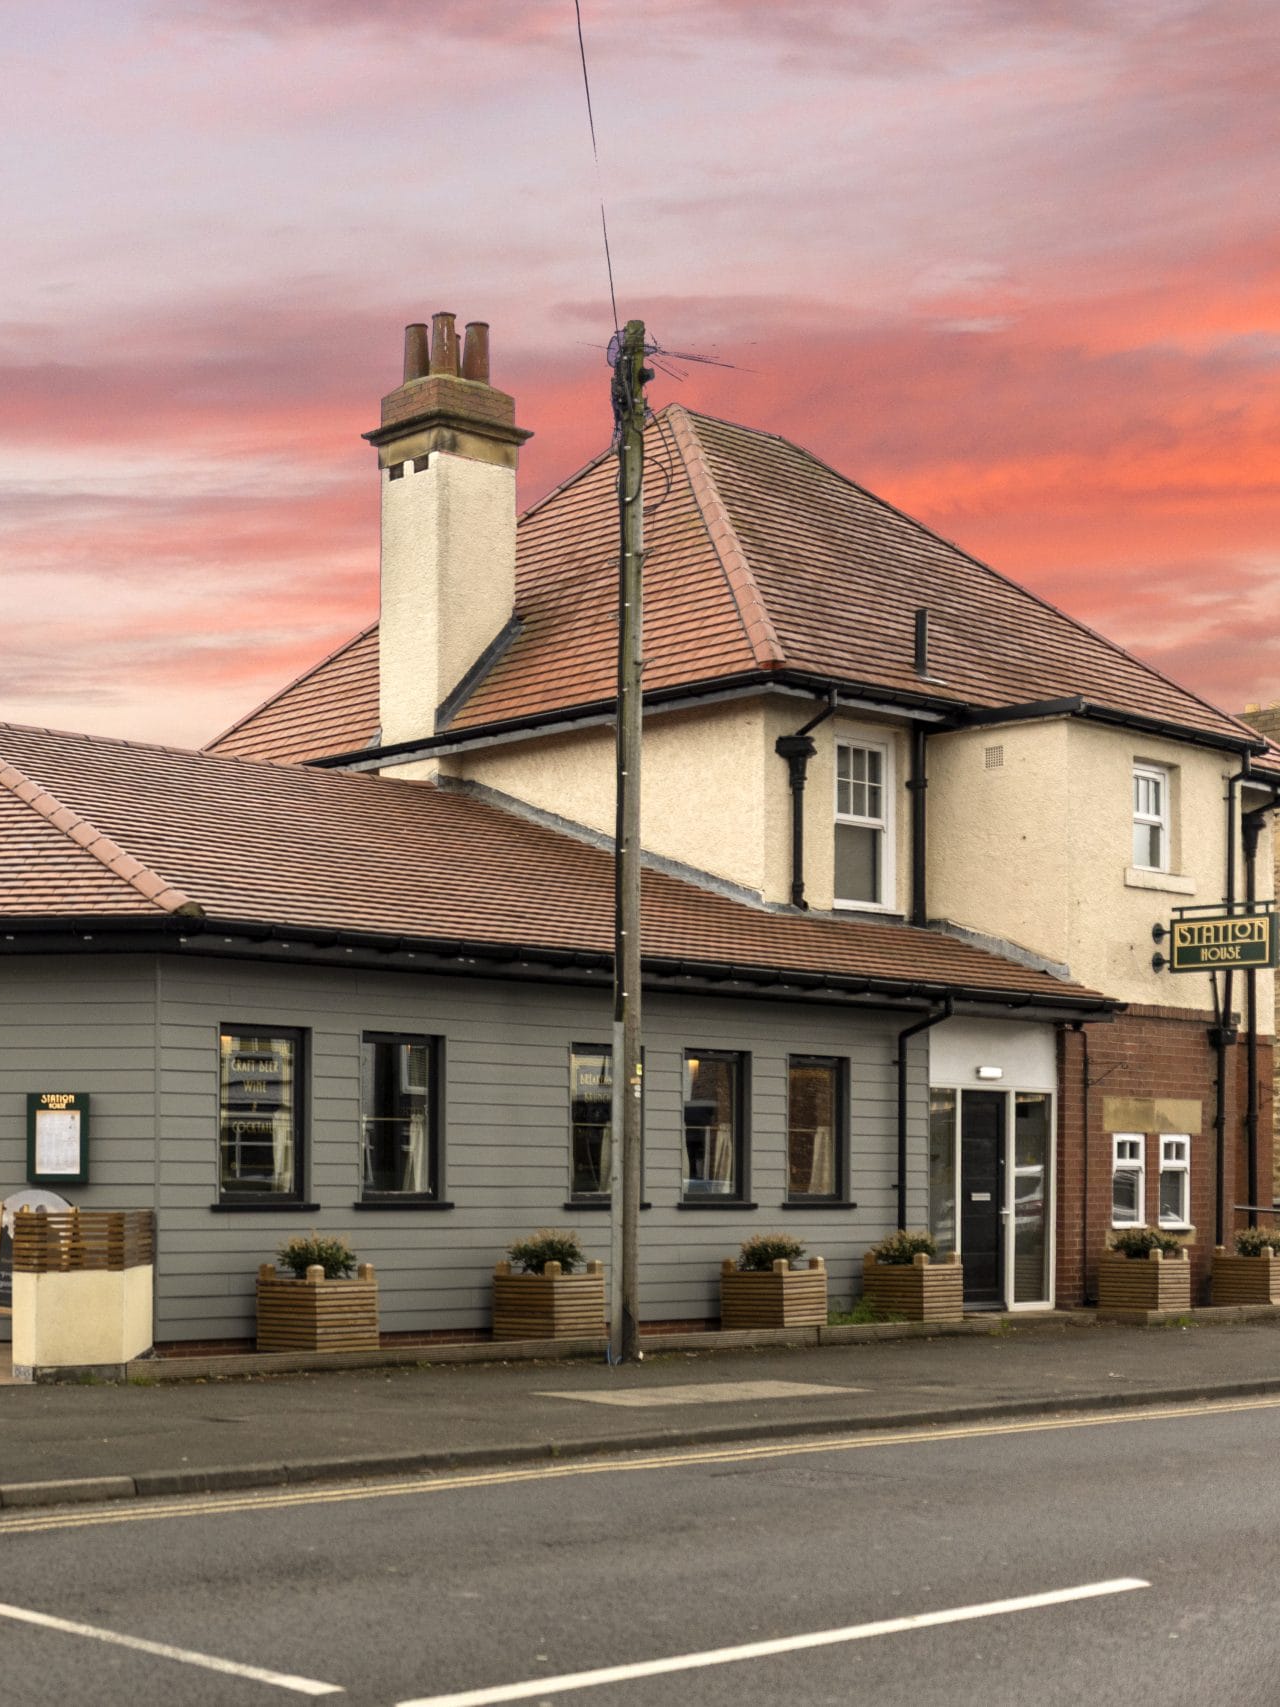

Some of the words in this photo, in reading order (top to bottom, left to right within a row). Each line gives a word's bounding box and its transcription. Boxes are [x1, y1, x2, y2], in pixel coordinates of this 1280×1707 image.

[1177, 921, 1265, 947] STATION
[1200, 946, 1241, 961] HOUSE
[231, 1059, 255, 1072] CRAFT
[258, 1060, 279, 1072] BEER
[243, 1080, 267, 1093] WINE
[40, 1094, 75, 1104] STATION
